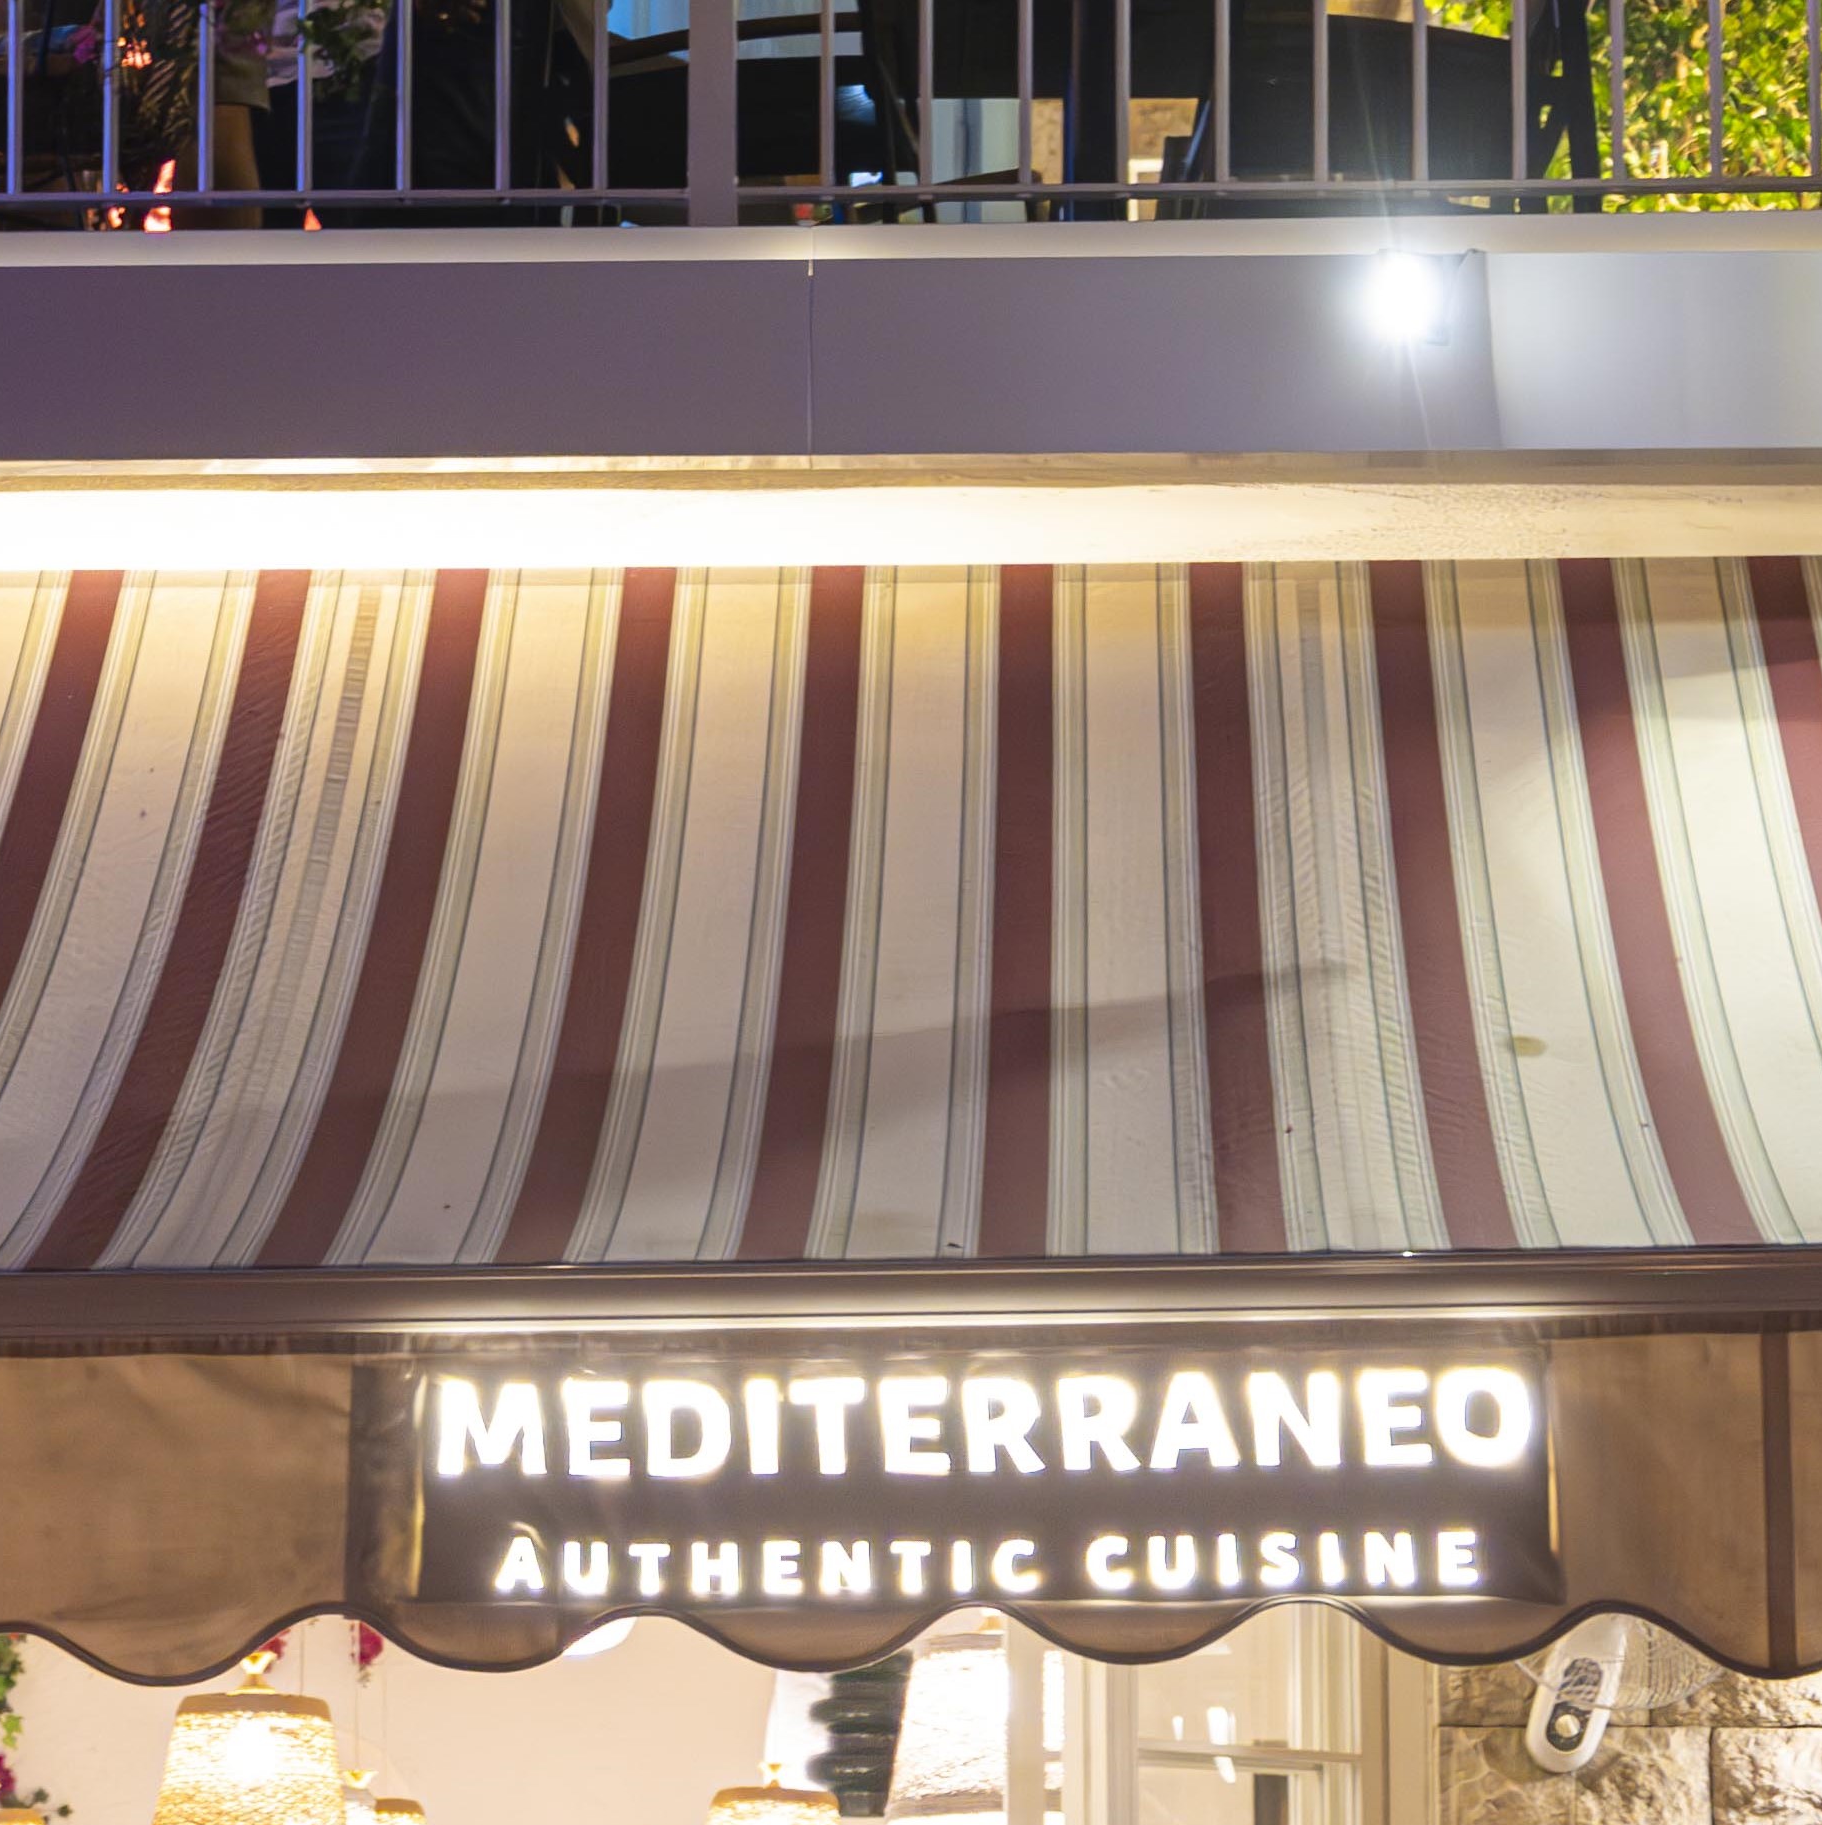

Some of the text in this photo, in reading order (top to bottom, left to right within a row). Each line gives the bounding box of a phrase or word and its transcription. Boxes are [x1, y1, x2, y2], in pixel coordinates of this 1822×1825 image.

[436, 1366, 1531, 1478] MEDITERRANEO
[493, 1529, 1480, 1597] AUTHENTIC CUISINE
